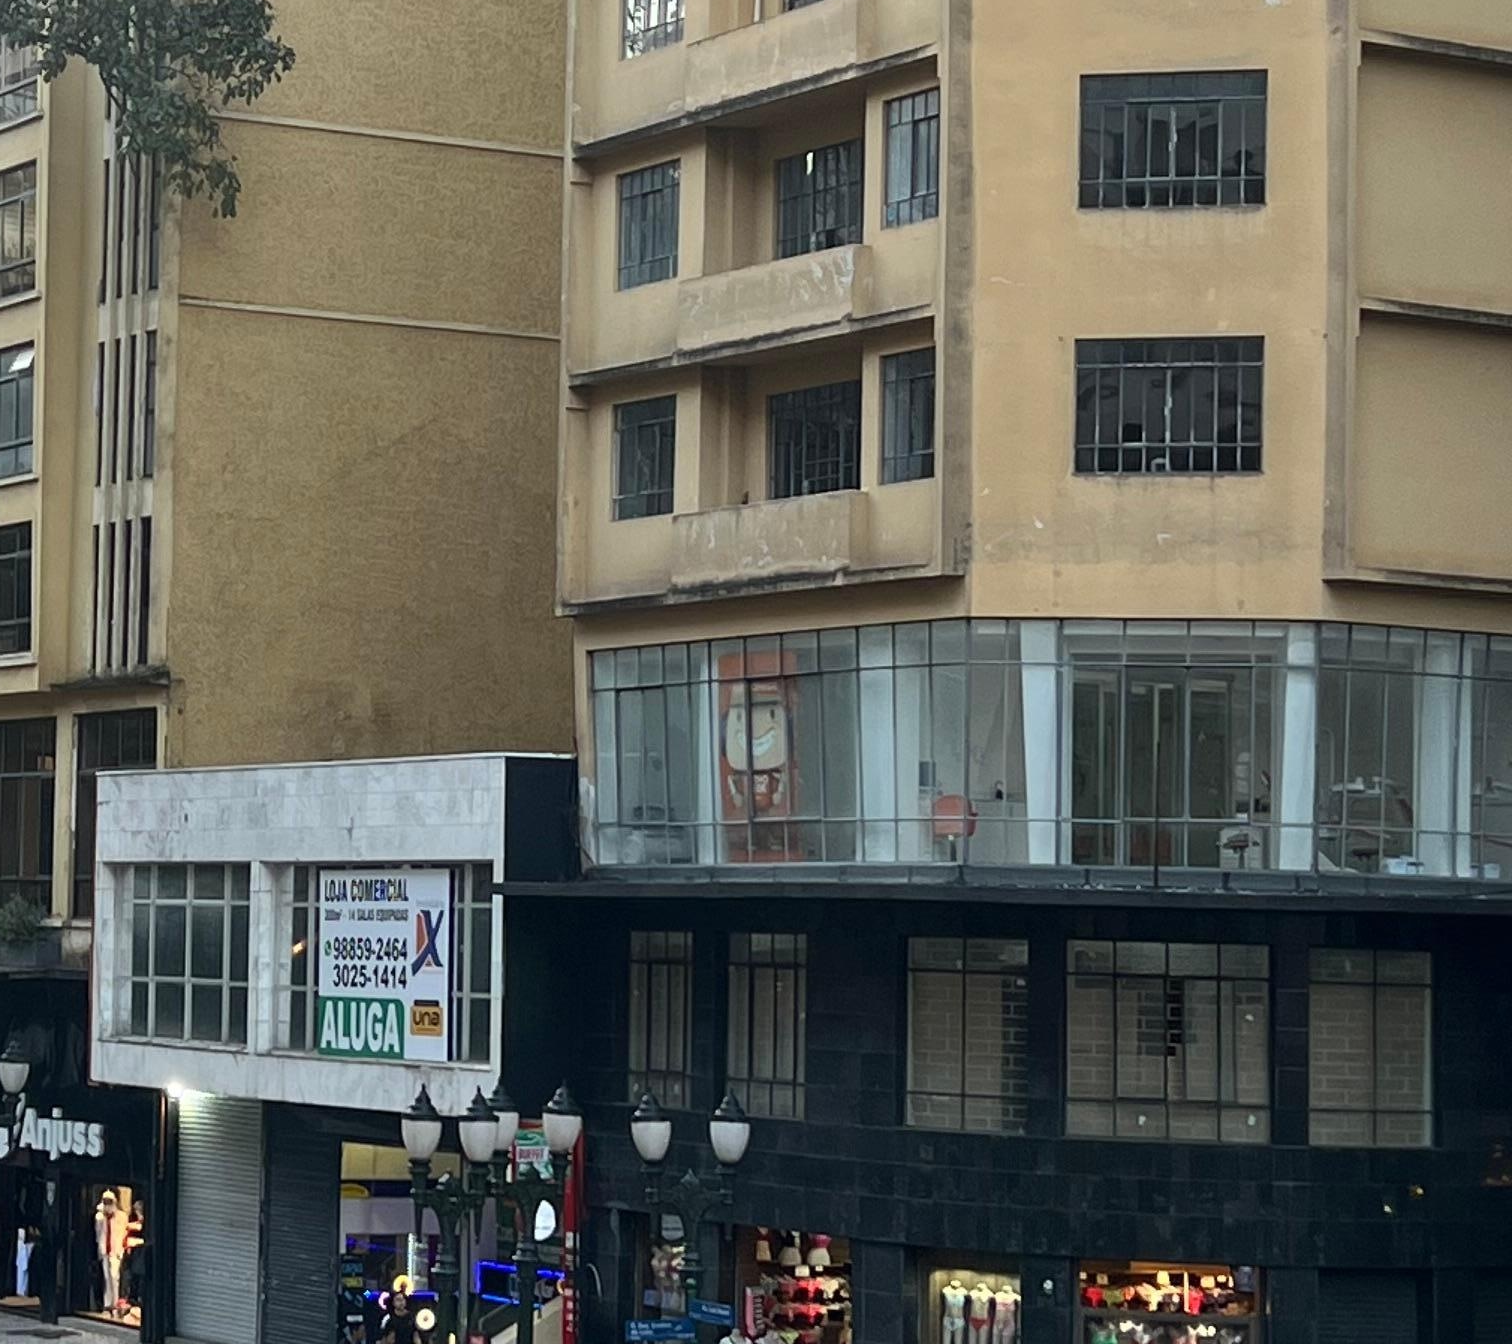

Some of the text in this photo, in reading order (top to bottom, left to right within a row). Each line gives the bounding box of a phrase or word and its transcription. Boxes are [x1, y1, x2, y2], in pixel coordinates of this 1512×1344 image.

[324, 878, 409, 902] LOJA COMERCIAL
[333, 936, 408, 962] 98859-2464
[333, 964, 408, 989] 3025-1414
[319, 1000, 401, 1053] ALUGA
[412, 1010, 441, 1026] una
[19, 1107, 105, 1160] Anjuss
